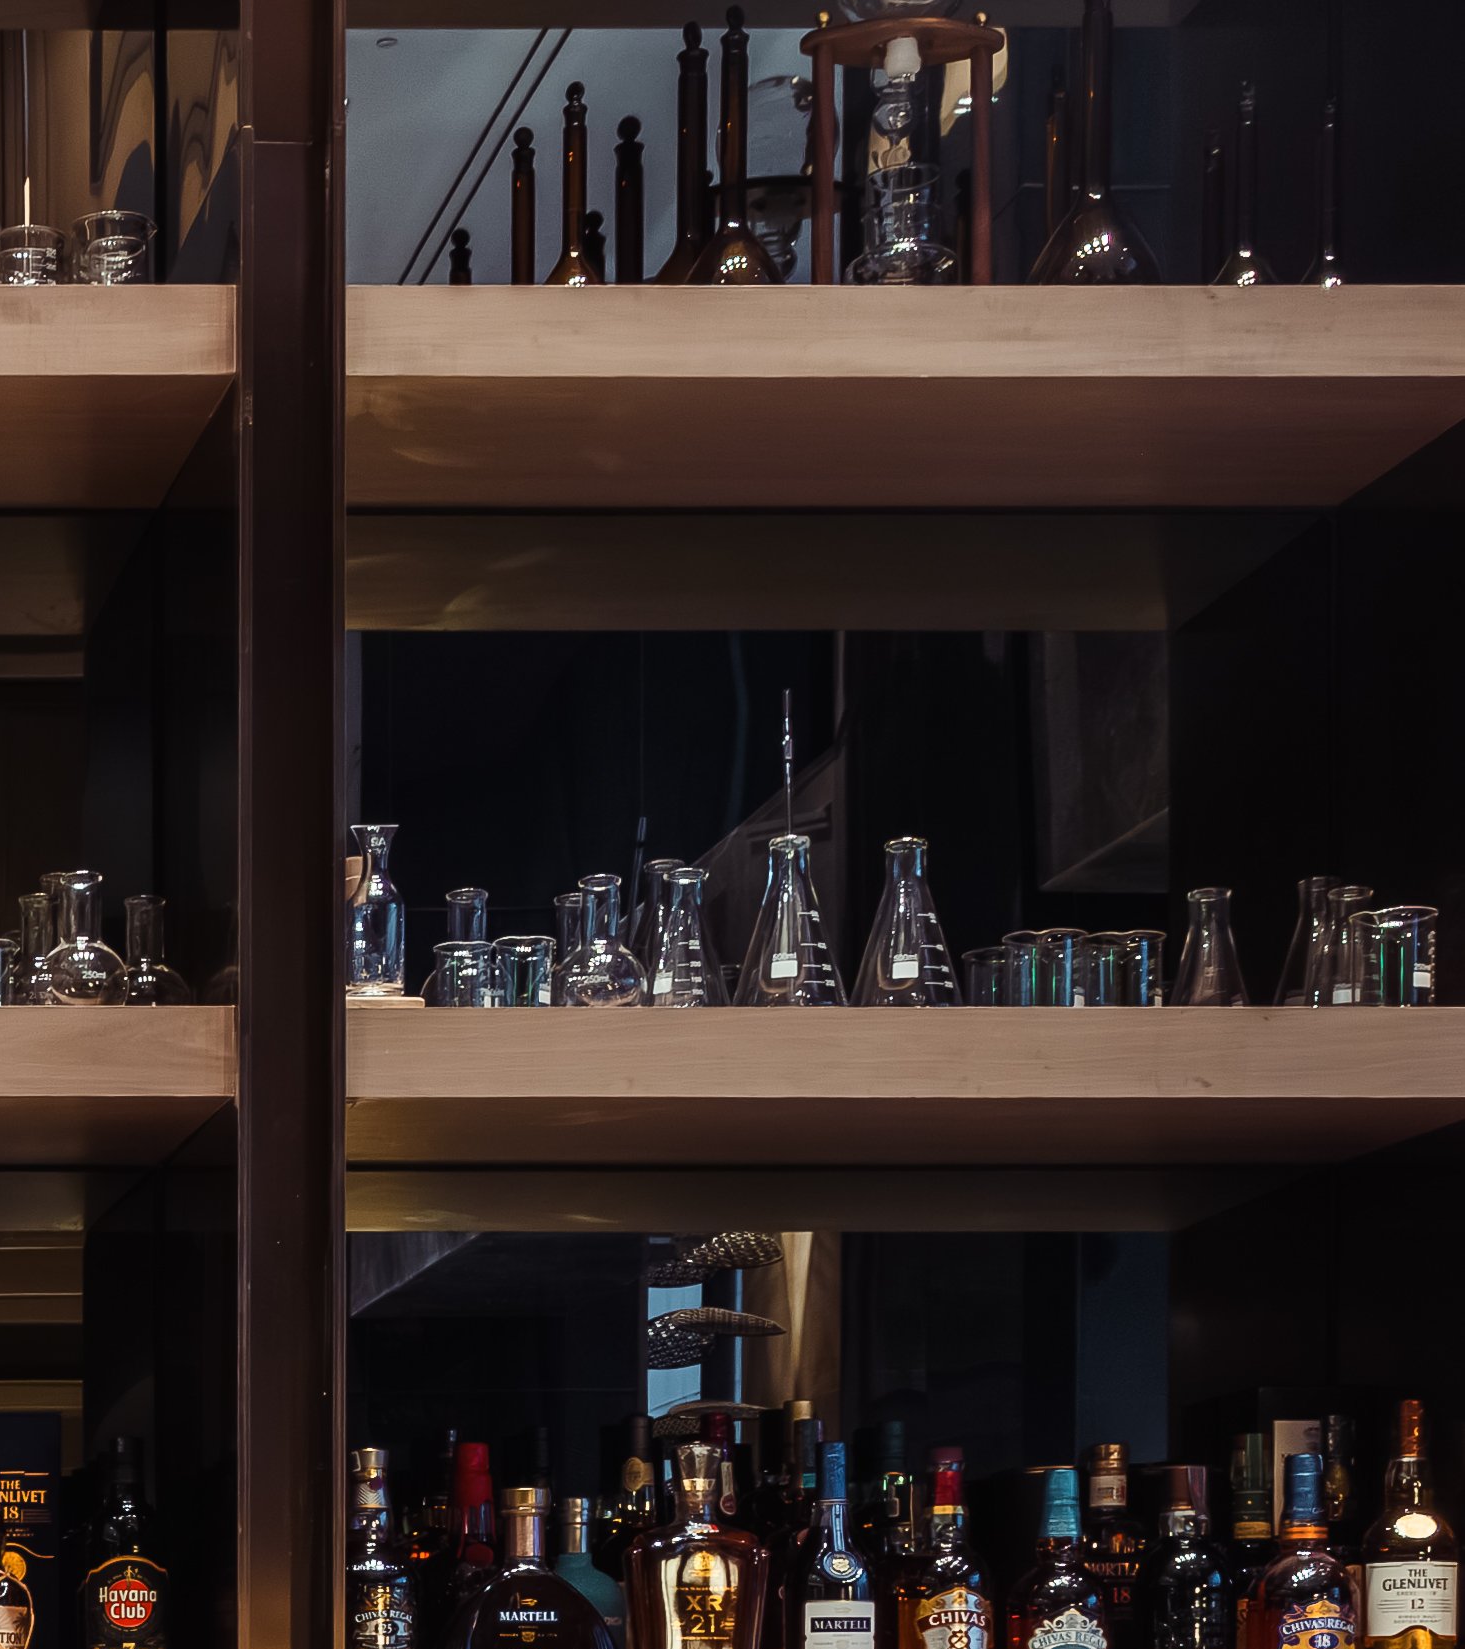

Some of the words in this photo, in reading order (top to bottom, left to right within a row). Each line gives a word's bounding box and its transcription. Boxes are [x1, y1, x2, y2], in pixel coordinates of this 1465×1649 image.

[82, 970, 106, 980] 250ml
[0, 1479, 21, 1490] THE
[0, 1490, 47, 1504] NLIVET
[3, 1505, 19, 1520] 18
[1408, 1568, 1428, 1578] THE
[1382, 1577, 1449, 1593] GLENLIVET
[98, 1586, 157, 1603] Havana
[685, 1594, 723, 1611] XR
[1410, 1598, 1424, 1610] 12
[110, 1602, 146, 1619] Club
[355, 1609, 388, 1624] CHIVAS
[389, 1609, 413, 1623] REGAL
[499, 1610, 558, 1622] MARTELL
[928, 1609, 987, 1627] CHIVAS
[691, 1613, 717, 1634] 21
[814, 1619, 869, 1631] MARTELL
[1282, 1616, 1325, 1635] CHIVAS
[1325, 1616, 1356, 1634] REGAL
[1074, 1630, 1105, 1649] REGAL
[1314, 1634, 1331, 1648] 18
